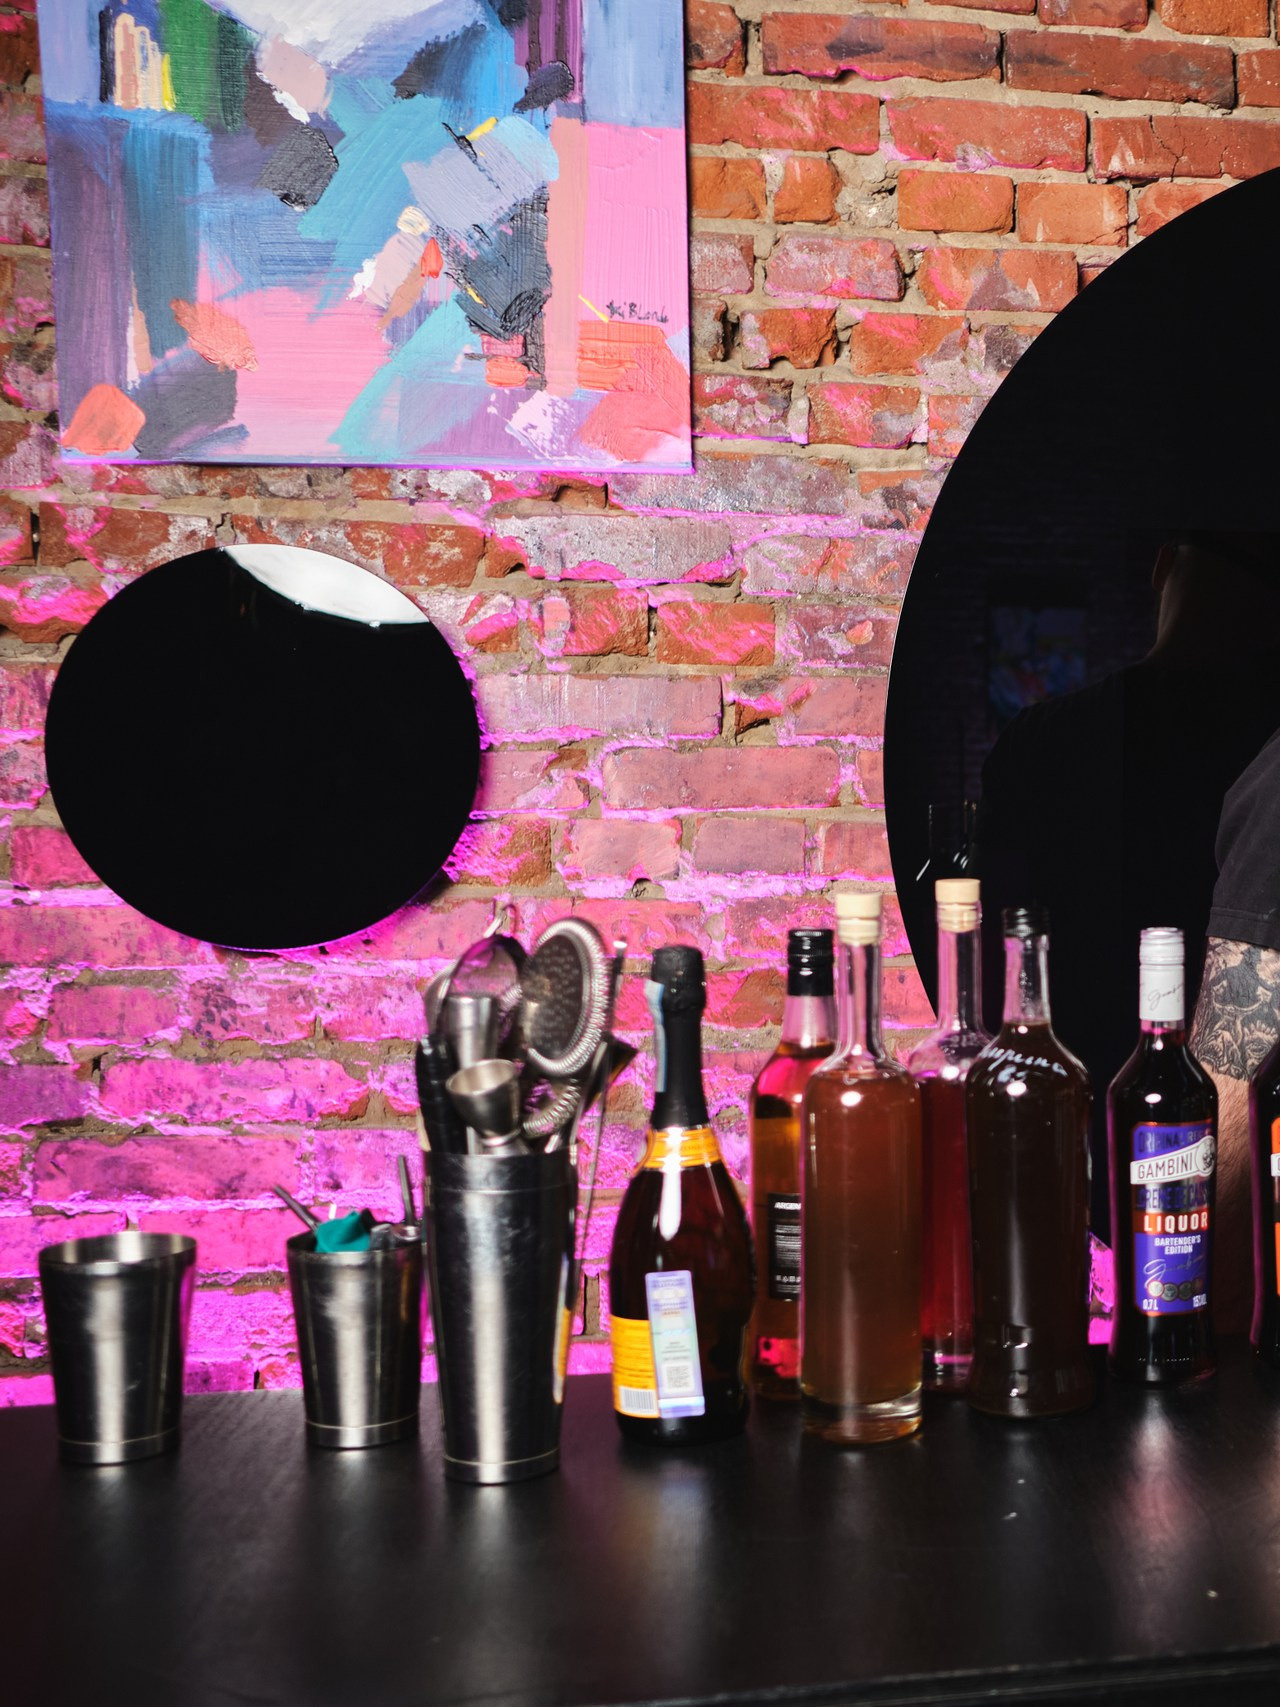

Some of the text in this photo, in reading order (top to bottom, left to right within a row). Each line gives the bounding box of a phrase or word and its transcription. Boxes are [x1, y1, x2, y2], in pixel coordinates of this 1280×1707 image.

[1138, 1151, 1193, 1180] GAMBINI
[1143, 1212, 1209, 1233] LIQUOR
[1154, 1234, 1202, 1247] BARTENDER'S
[1164, 1245, 1193, 1255] EDITION
